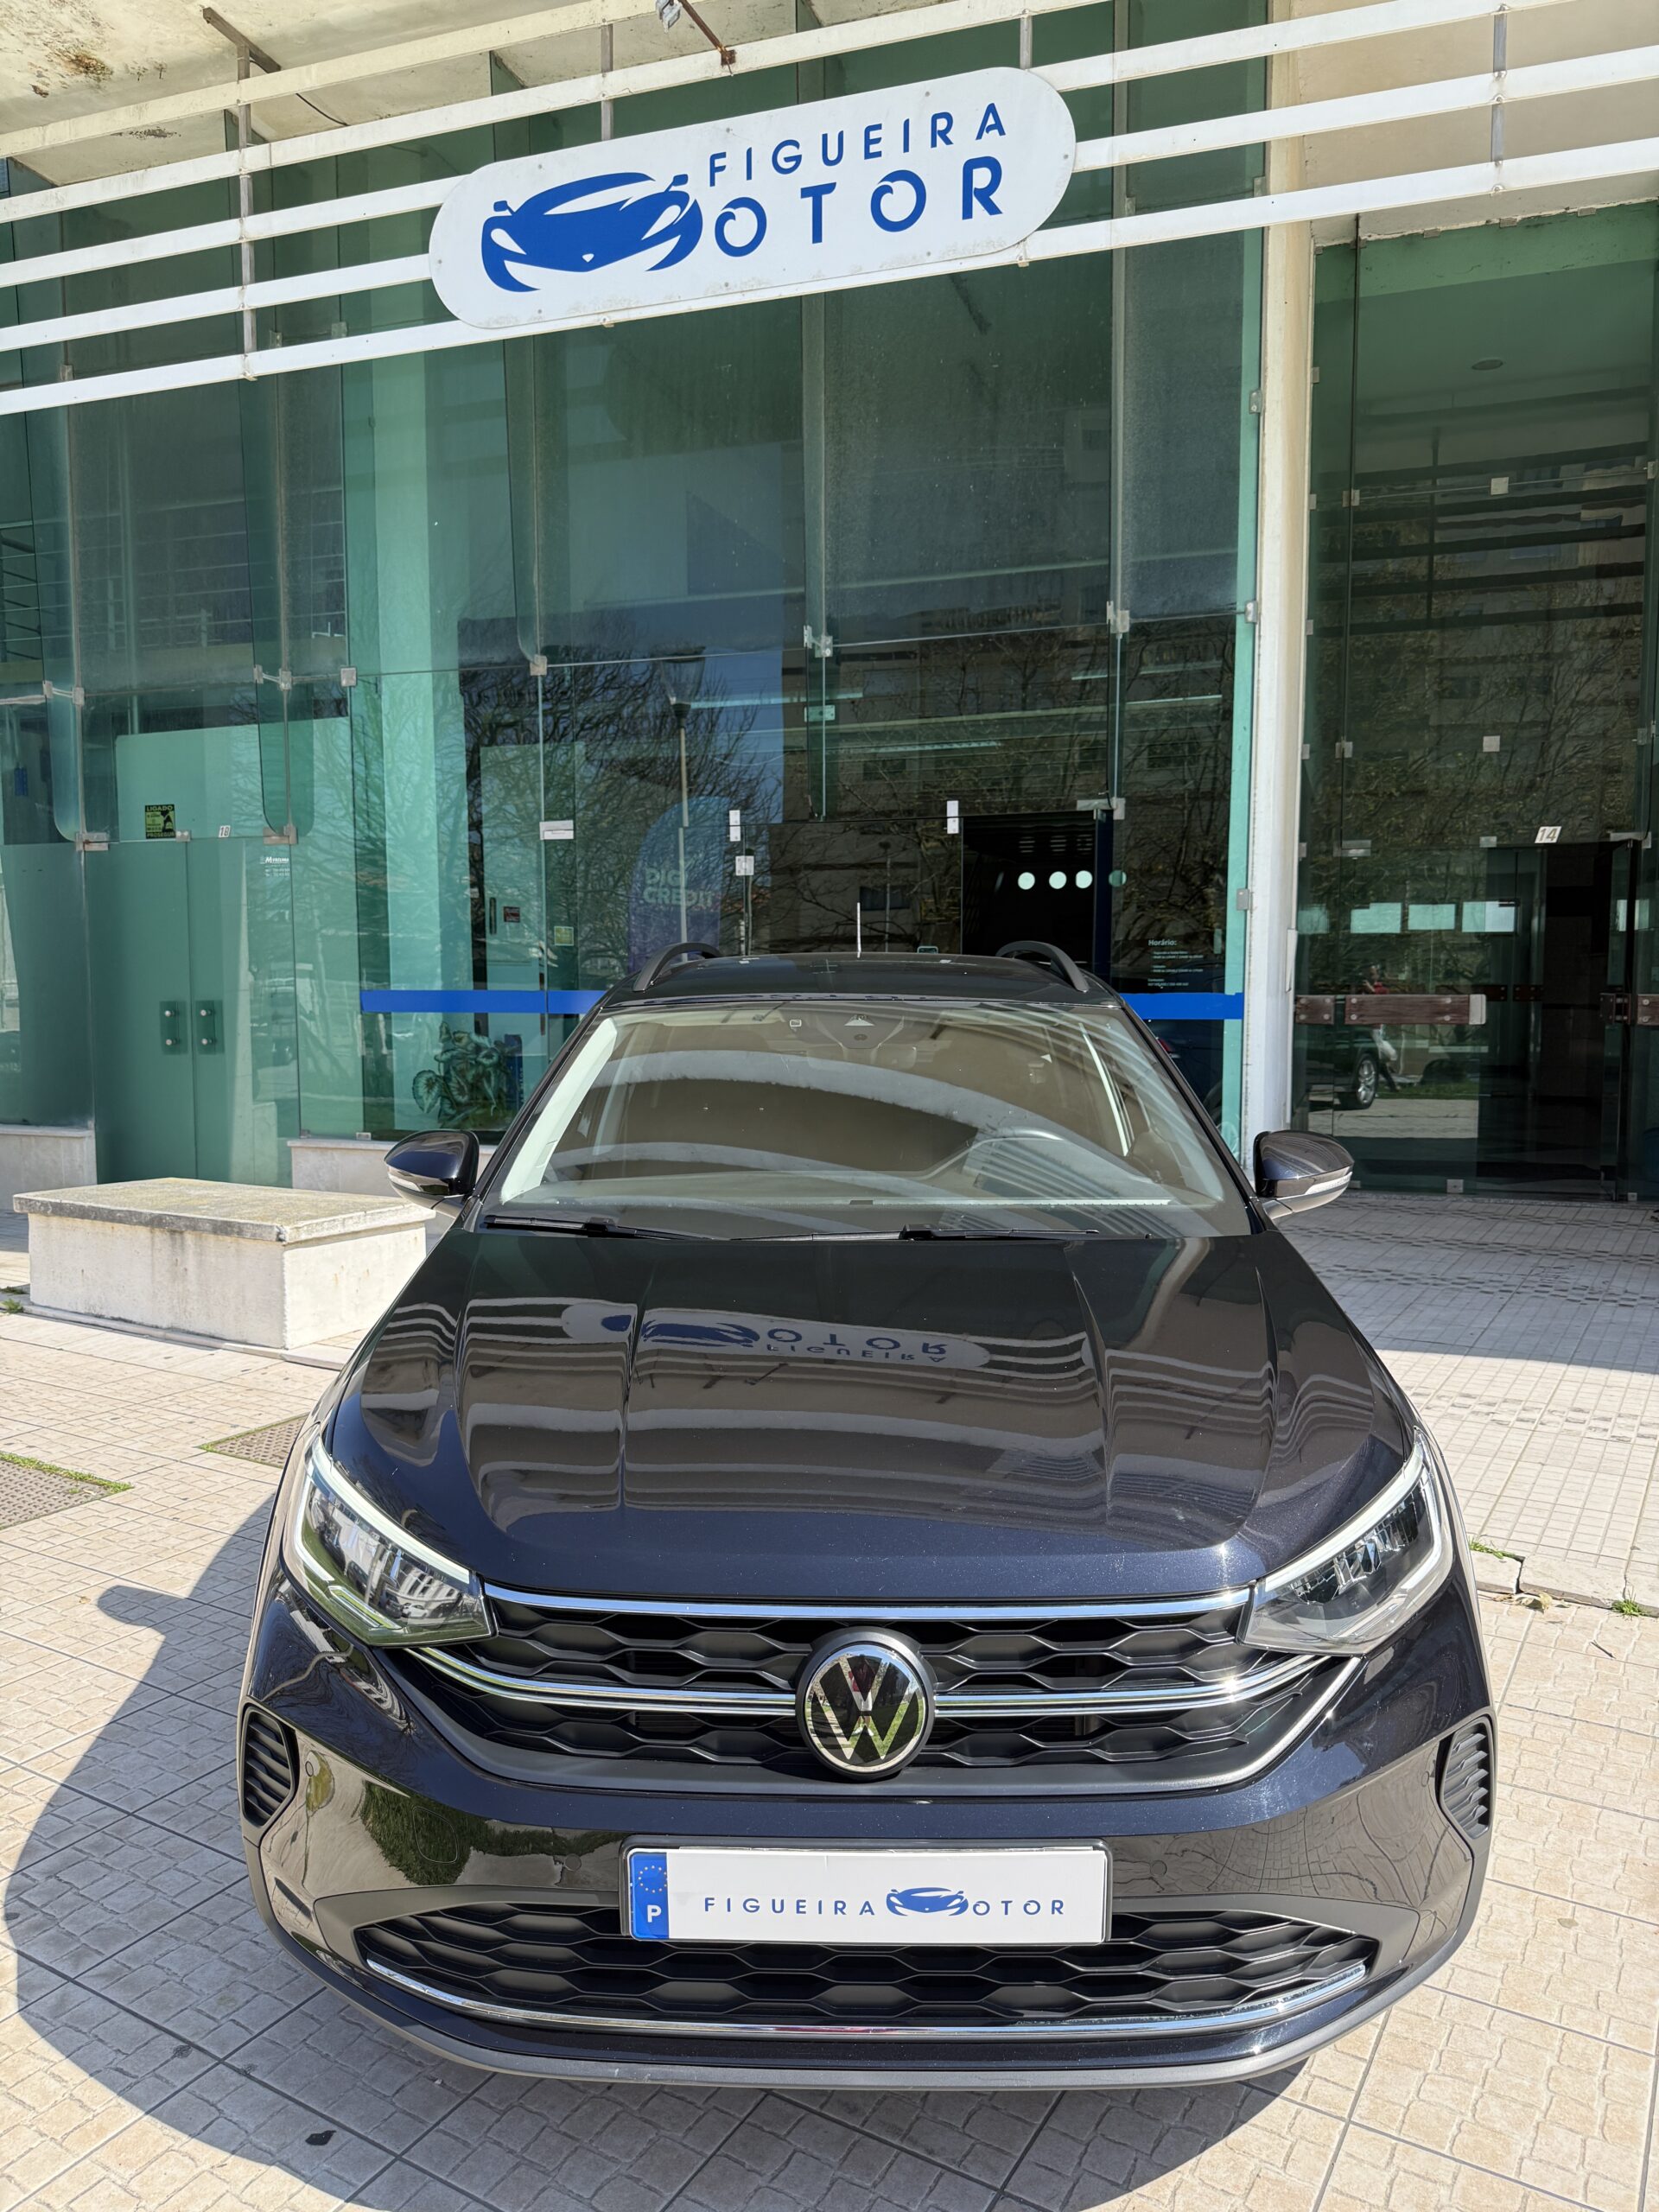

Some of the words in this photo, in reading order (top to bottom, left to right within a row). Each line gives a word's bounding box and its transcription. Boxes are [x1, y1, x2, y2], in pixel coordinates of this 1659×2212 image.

[709, 103, 1006, 188] FIGUEIRA
[1538, 828, 1558, 842] 14
[647, 1904, 662, 1923] P
[704, 1897, 875, 1916] FIGUEIRA
